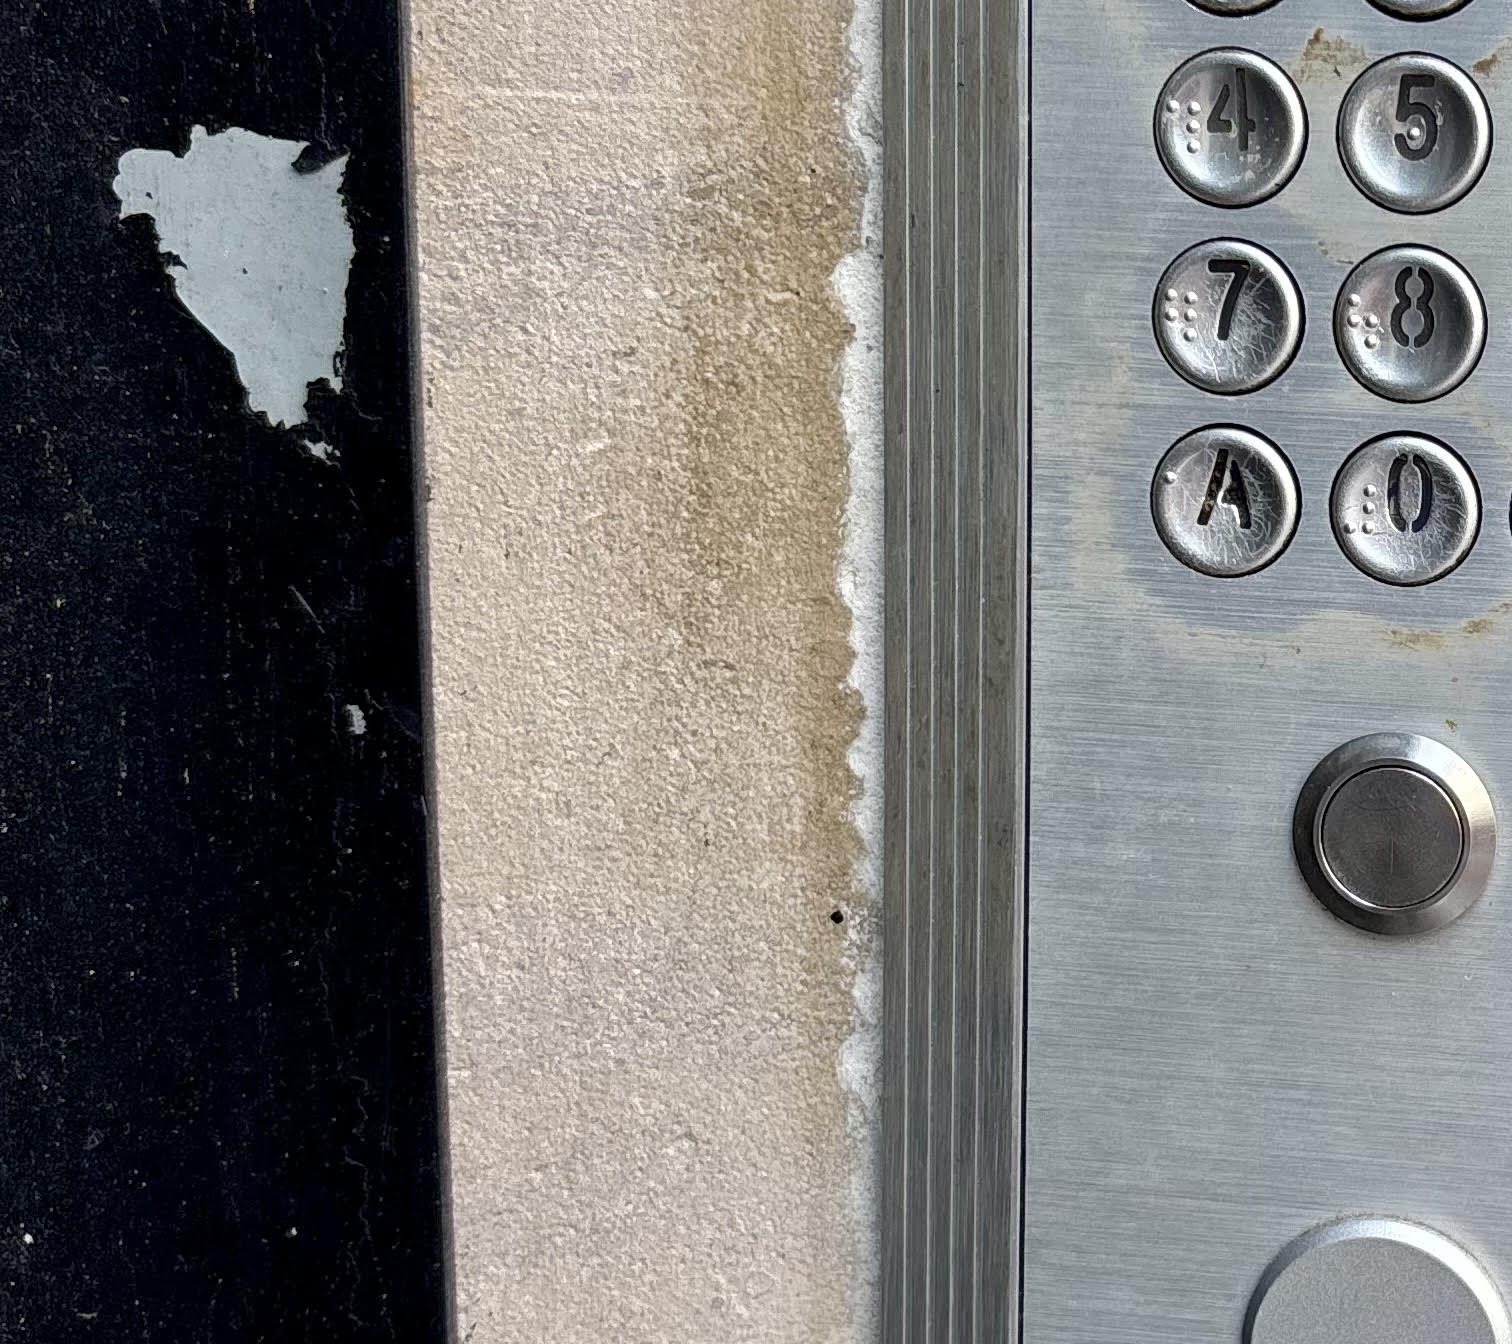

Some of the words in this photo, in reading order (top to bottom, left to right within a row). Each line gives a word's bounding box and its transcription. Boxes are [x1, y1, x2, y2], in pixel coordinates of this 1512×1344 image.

[1206, 69, 1257, 151] 4
[1394, 74, 1439, 161] 5
[1208, 260, 1250, 341] 7
[1389, 267, 1434, 348] 8
[1197, 448, 1253, 530] A
[1387, 454, 1433, 533] 0
